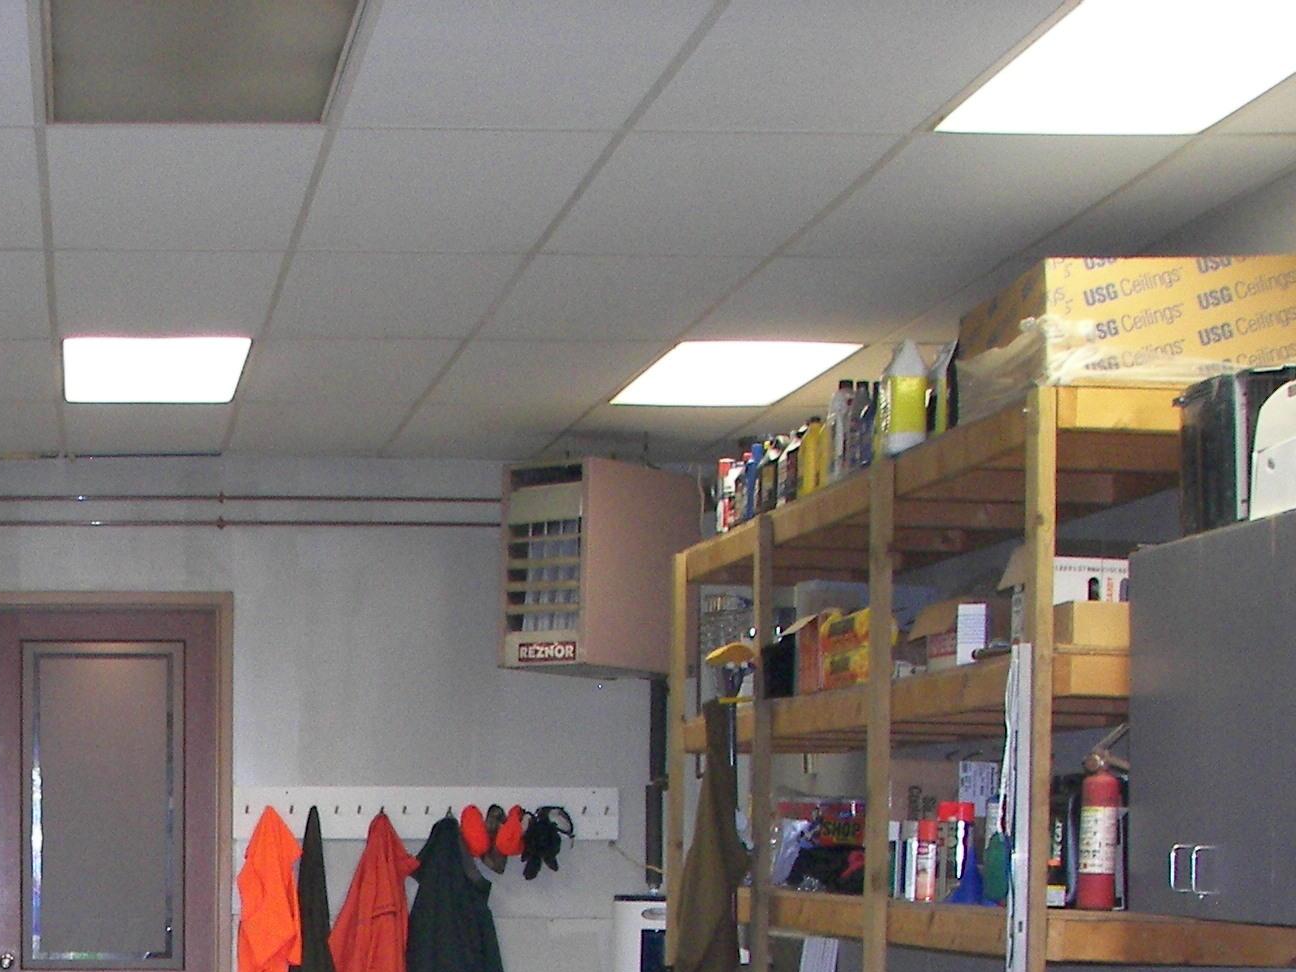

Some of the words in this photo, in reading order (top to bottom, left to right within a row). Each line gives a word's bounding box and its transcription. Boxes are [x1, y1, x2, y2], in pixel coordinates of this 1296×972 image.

[1084, 283, 1118, 306] USG
[1120, 267, 1181, 296] Ceilings
[1197, 286, 1233, 309] USG
[1121, 305, 1182, 332] Ceilings
[1198, 322, 1233, 346] USG
[519, 644, 575, 659] REZNOR
